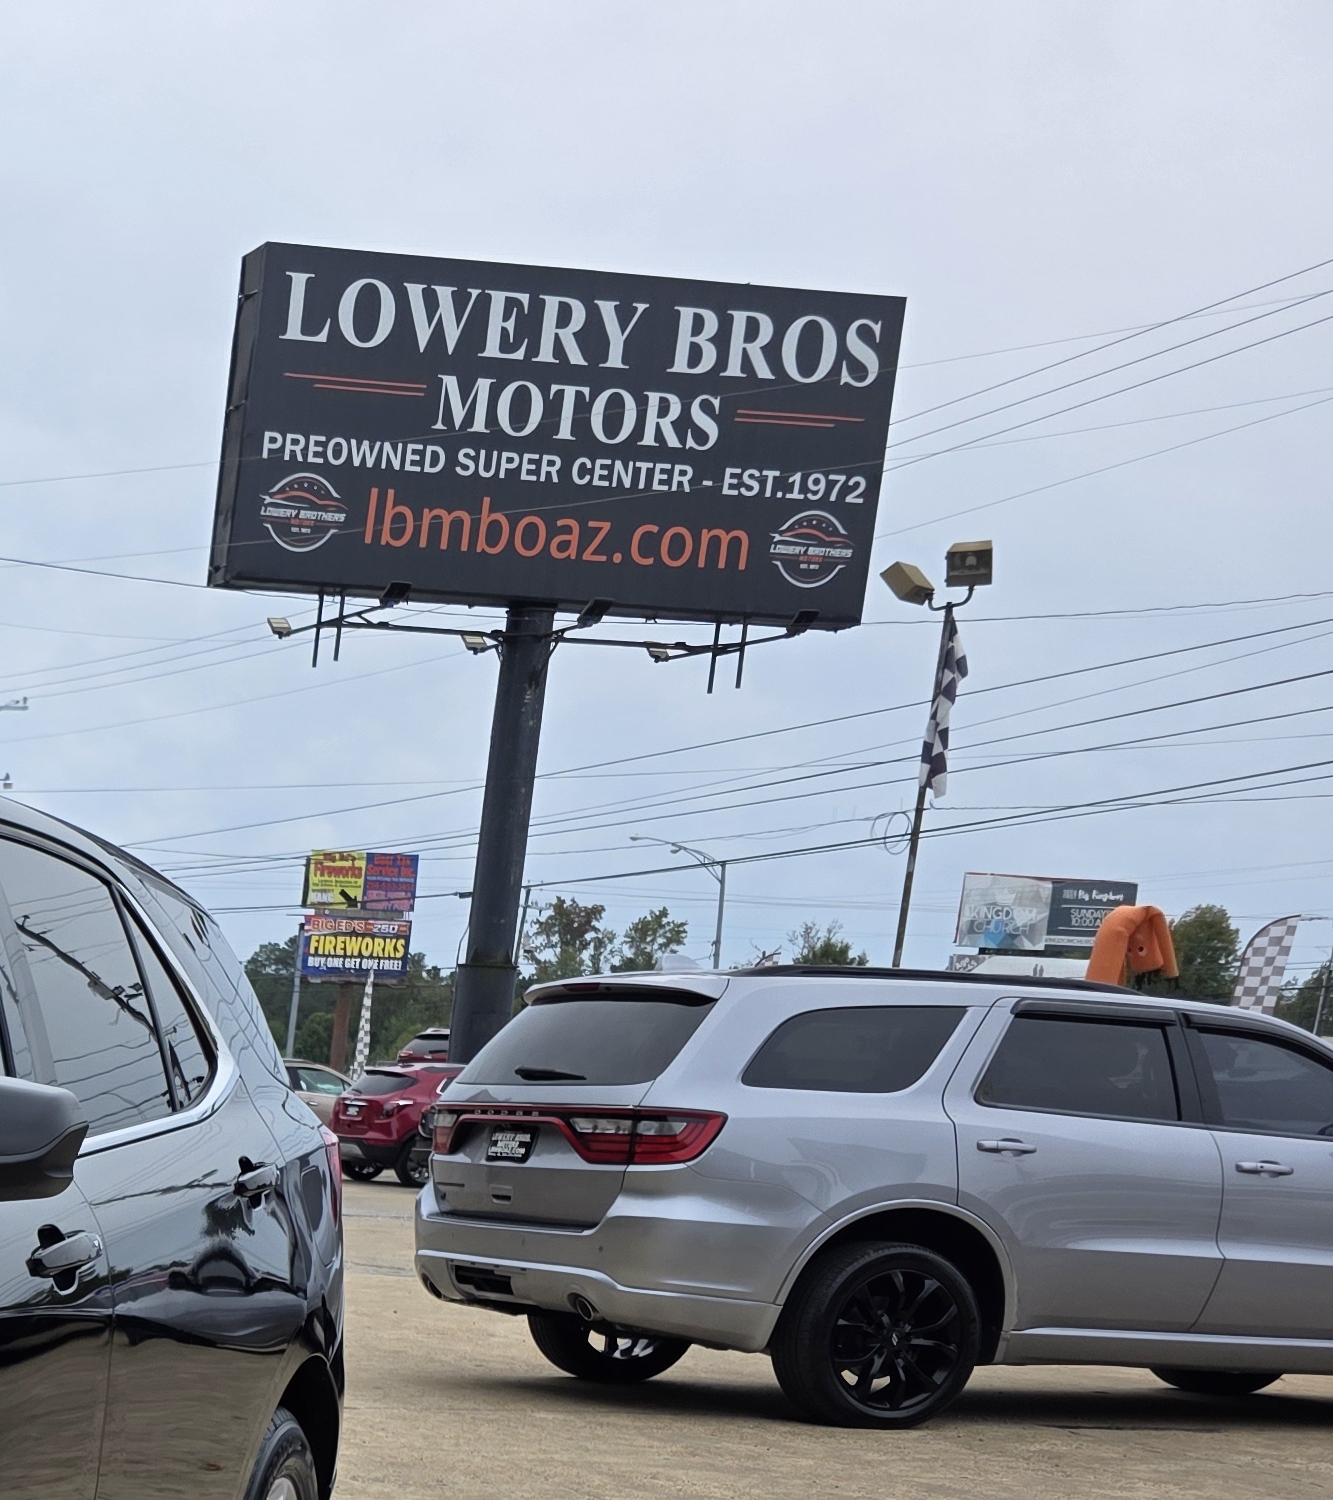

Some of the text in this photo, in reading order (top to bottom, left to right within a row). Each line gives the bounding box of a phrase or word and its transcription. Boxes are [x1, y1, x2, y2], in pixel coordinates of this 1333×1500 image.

[279, 271, 883, 388] LOWERY BROS
[431, 374, 721, 451] MOTORS
[261, 431, 446, 475] PREOWNED
[455, 447, 560, 483] SUPER
[571, 456, 694, 494] CENTER
[721, 467, 867, 504] EST.1972
[363, 487, 750, 571] lbmboaz.com
[308, 934, 406, 958] FIREWORKS
[311, 918, 335, 932] BIG
[973, 918, 1031, 935] CHURCH
[307, 956, 327, 968] BUY
[326, 956, 344, 969] ONE
[344, 957, 361, 970] GET
